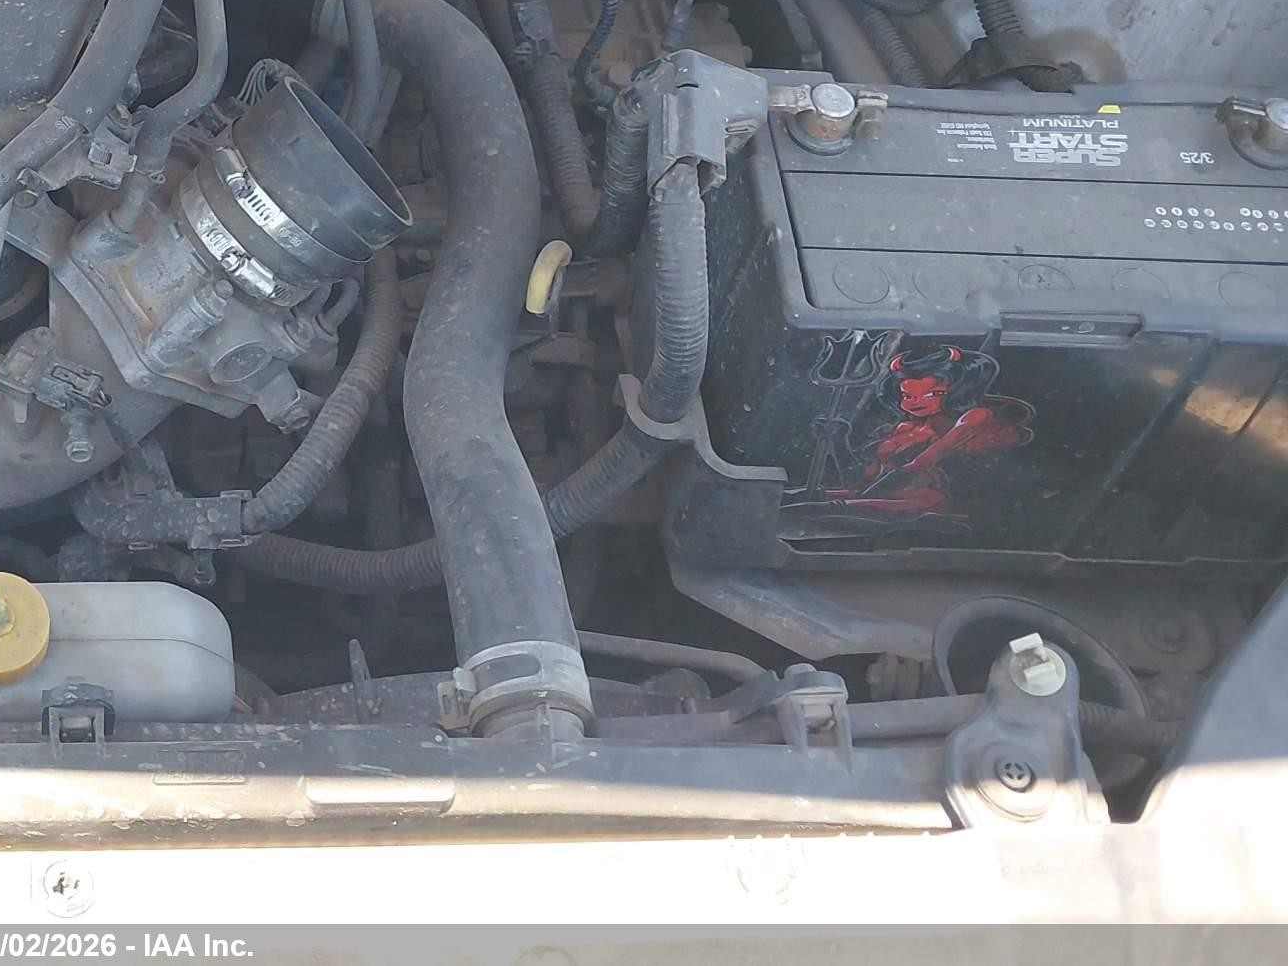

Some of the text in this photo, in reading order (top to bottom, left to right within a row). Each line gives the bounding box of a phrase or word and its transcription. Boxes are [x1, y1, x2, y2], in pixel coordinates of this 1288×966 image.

[1023, 118, 1120, 129] PLATINUM
[1009, 134, 1128, 155] START
[1014, 148, 1121, 167] SUPER
[1180, 151, 1215, 164] 3/25
